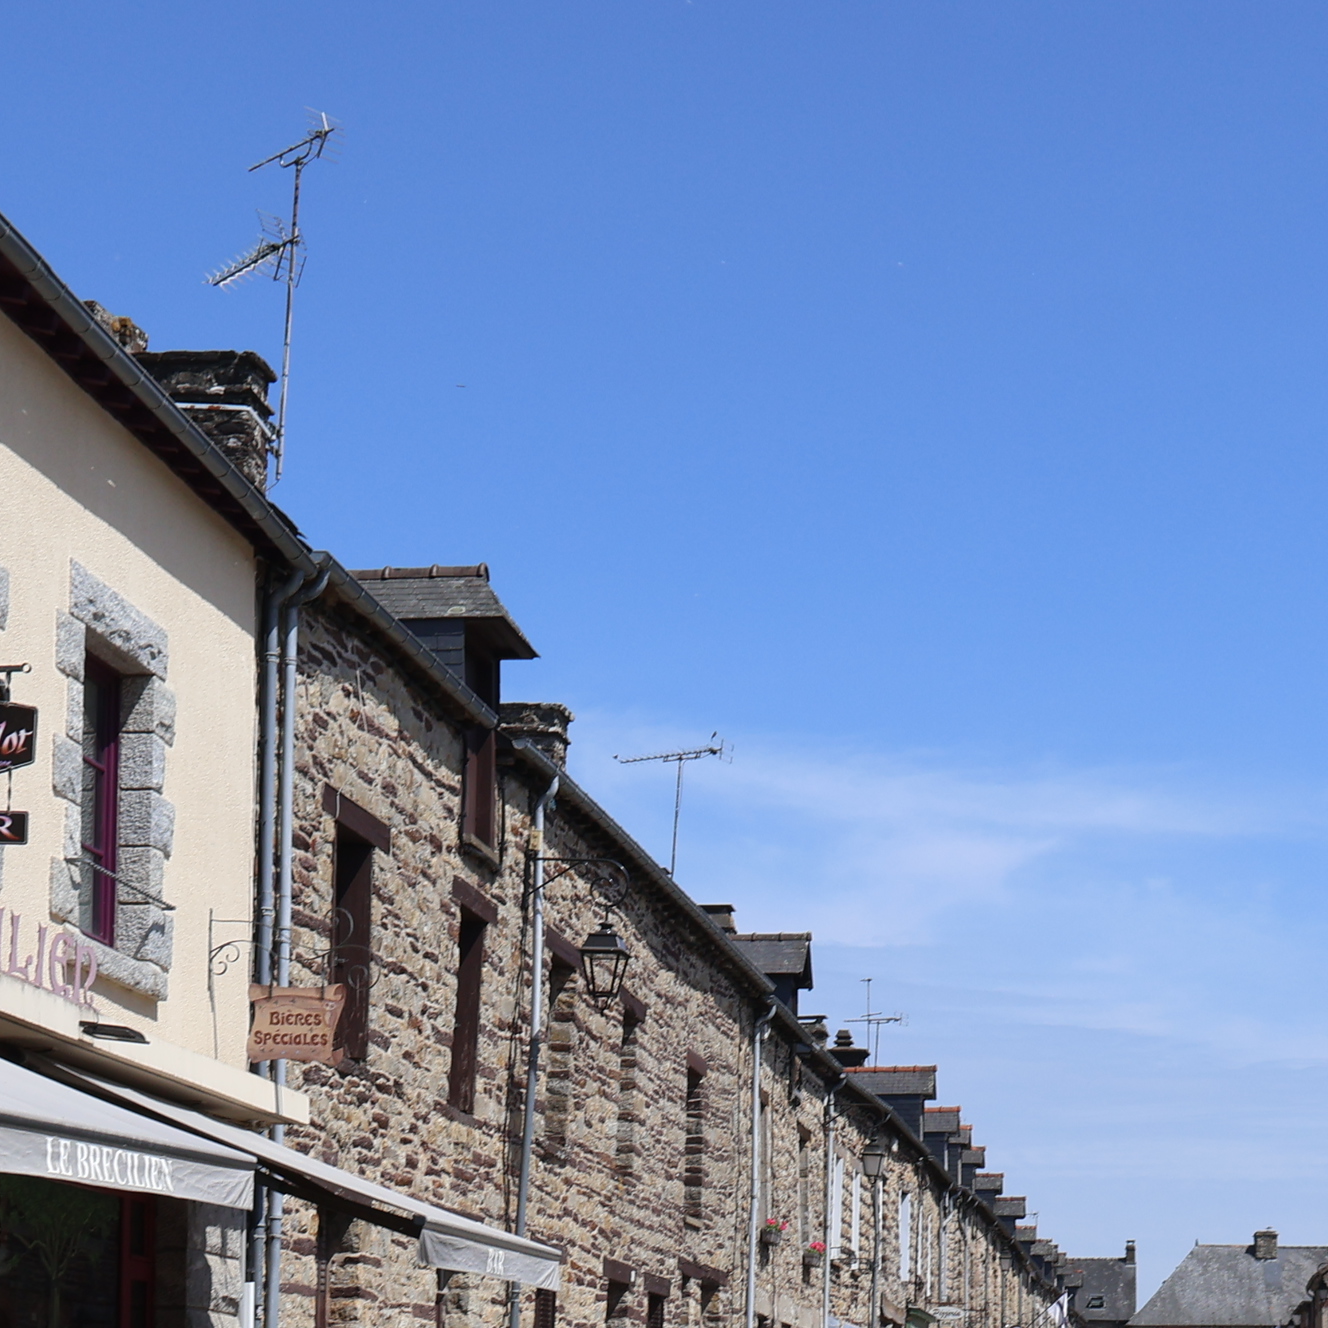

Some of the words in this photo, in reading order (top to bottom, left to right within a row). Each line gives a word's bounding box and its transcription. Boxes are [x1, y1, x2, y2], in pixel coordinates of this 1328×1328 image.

[45, 1135, 73, 1176] LE
[76, 1142, 174, 1192] BRECILIEN
[486, 1248, 505, 1275] BAR
